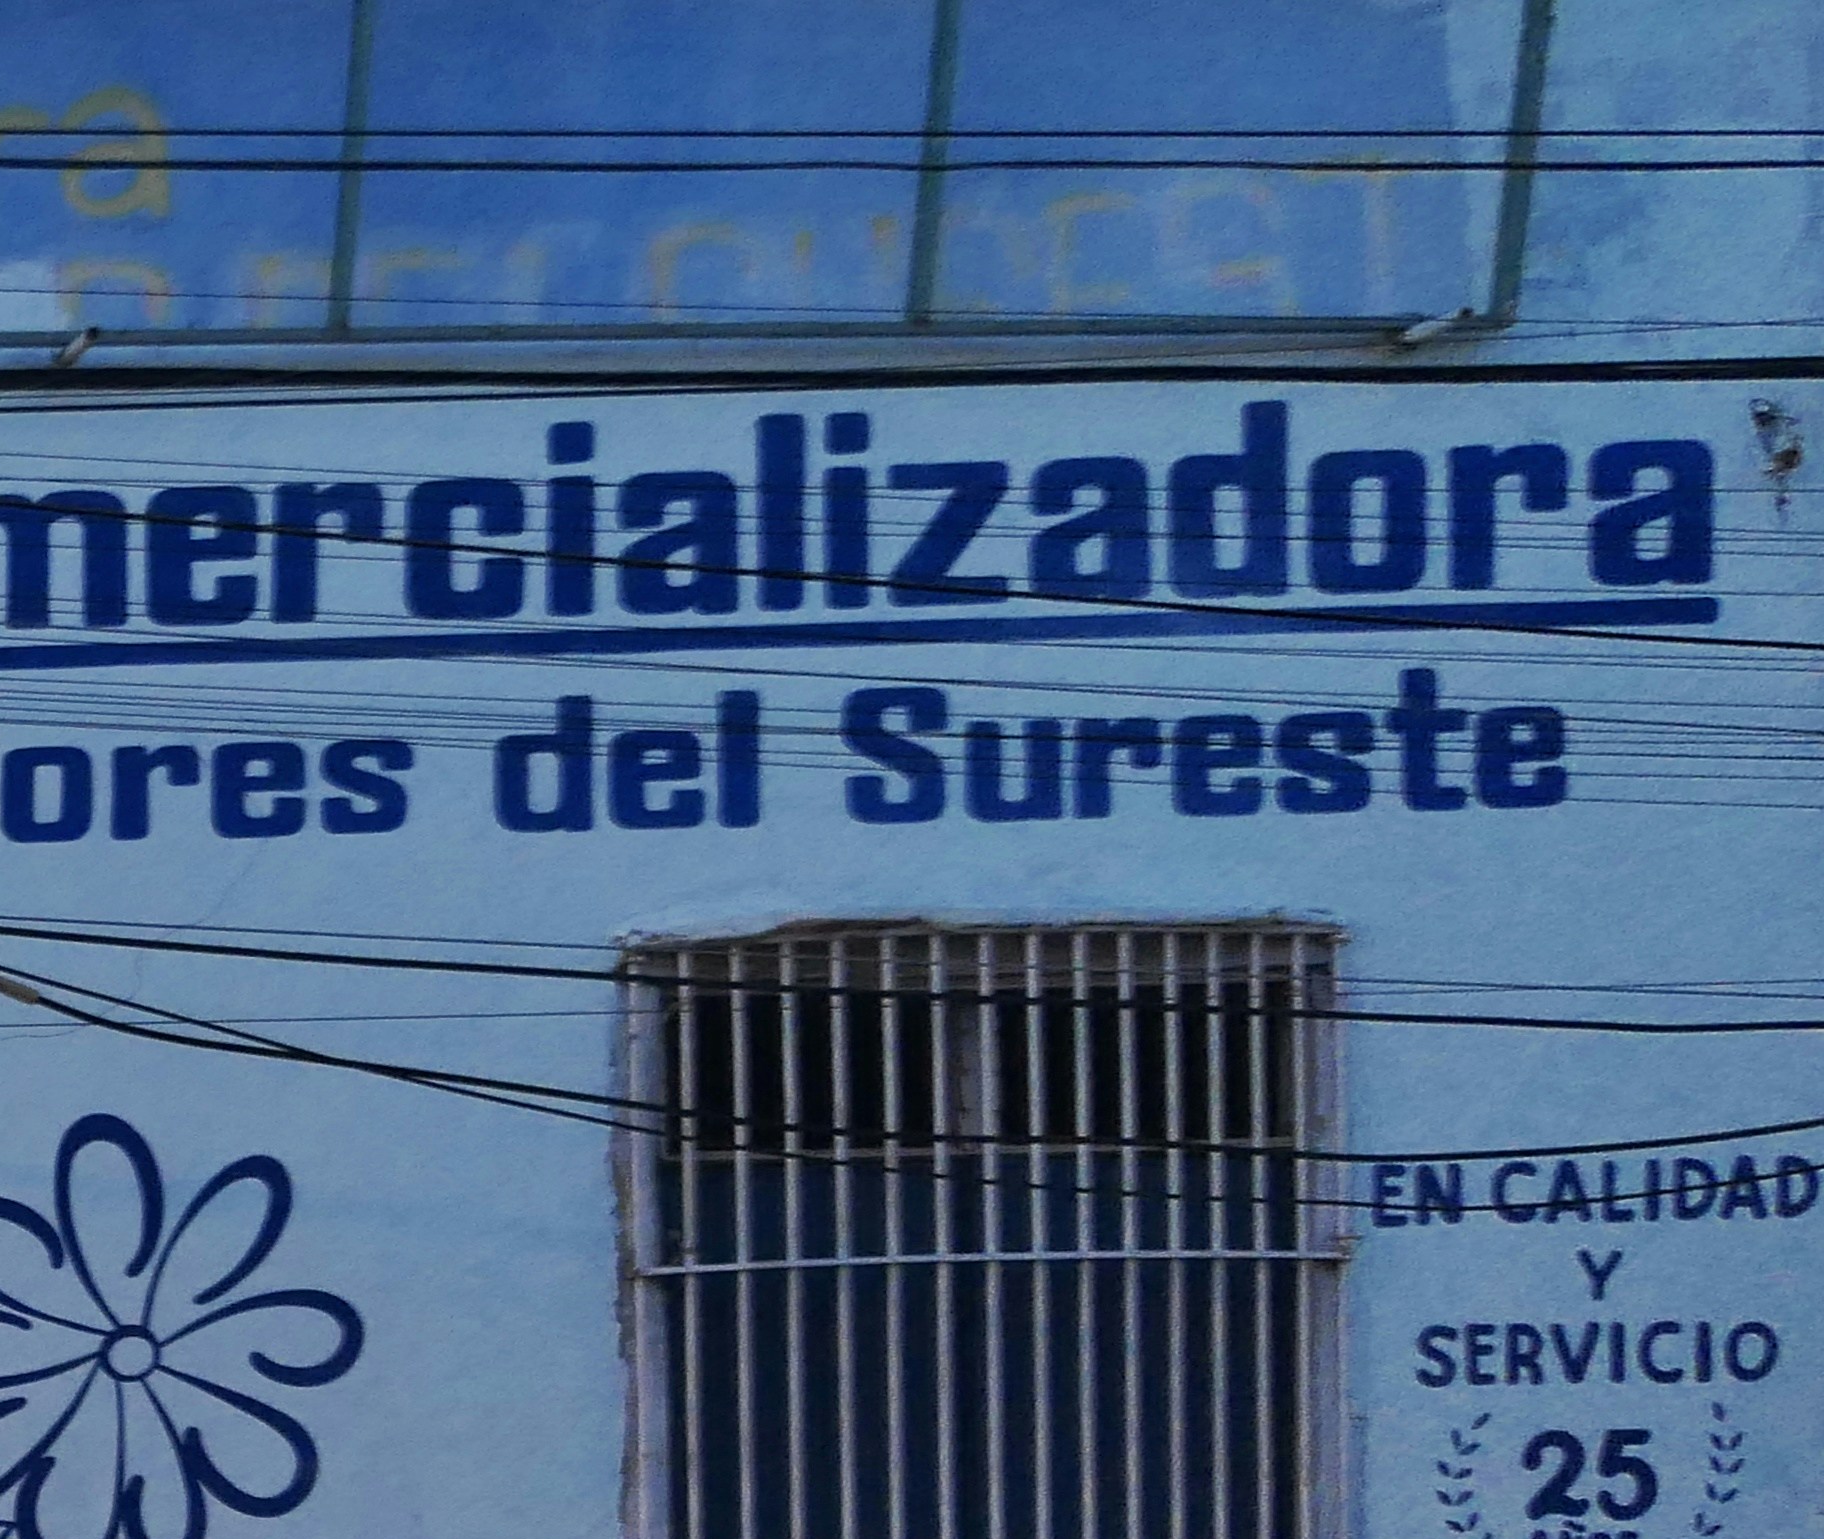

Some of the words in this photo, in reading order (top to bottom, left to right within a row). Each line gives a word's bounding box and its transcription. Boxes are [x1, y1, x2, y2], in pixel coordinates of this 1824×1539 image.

[492, 690, 759, 836] del
[843, 669, 1567, 823] Sureste
[1370, 1163, 1463, 1228] EN
[1491, 1154, 1818, 1224] CALIDAD
[1577, 1250, 1622, 1301] Y
[1416, 1320, 1778, 1388] SERVICIO
[1522, 1428, 1659, 1522] 25
